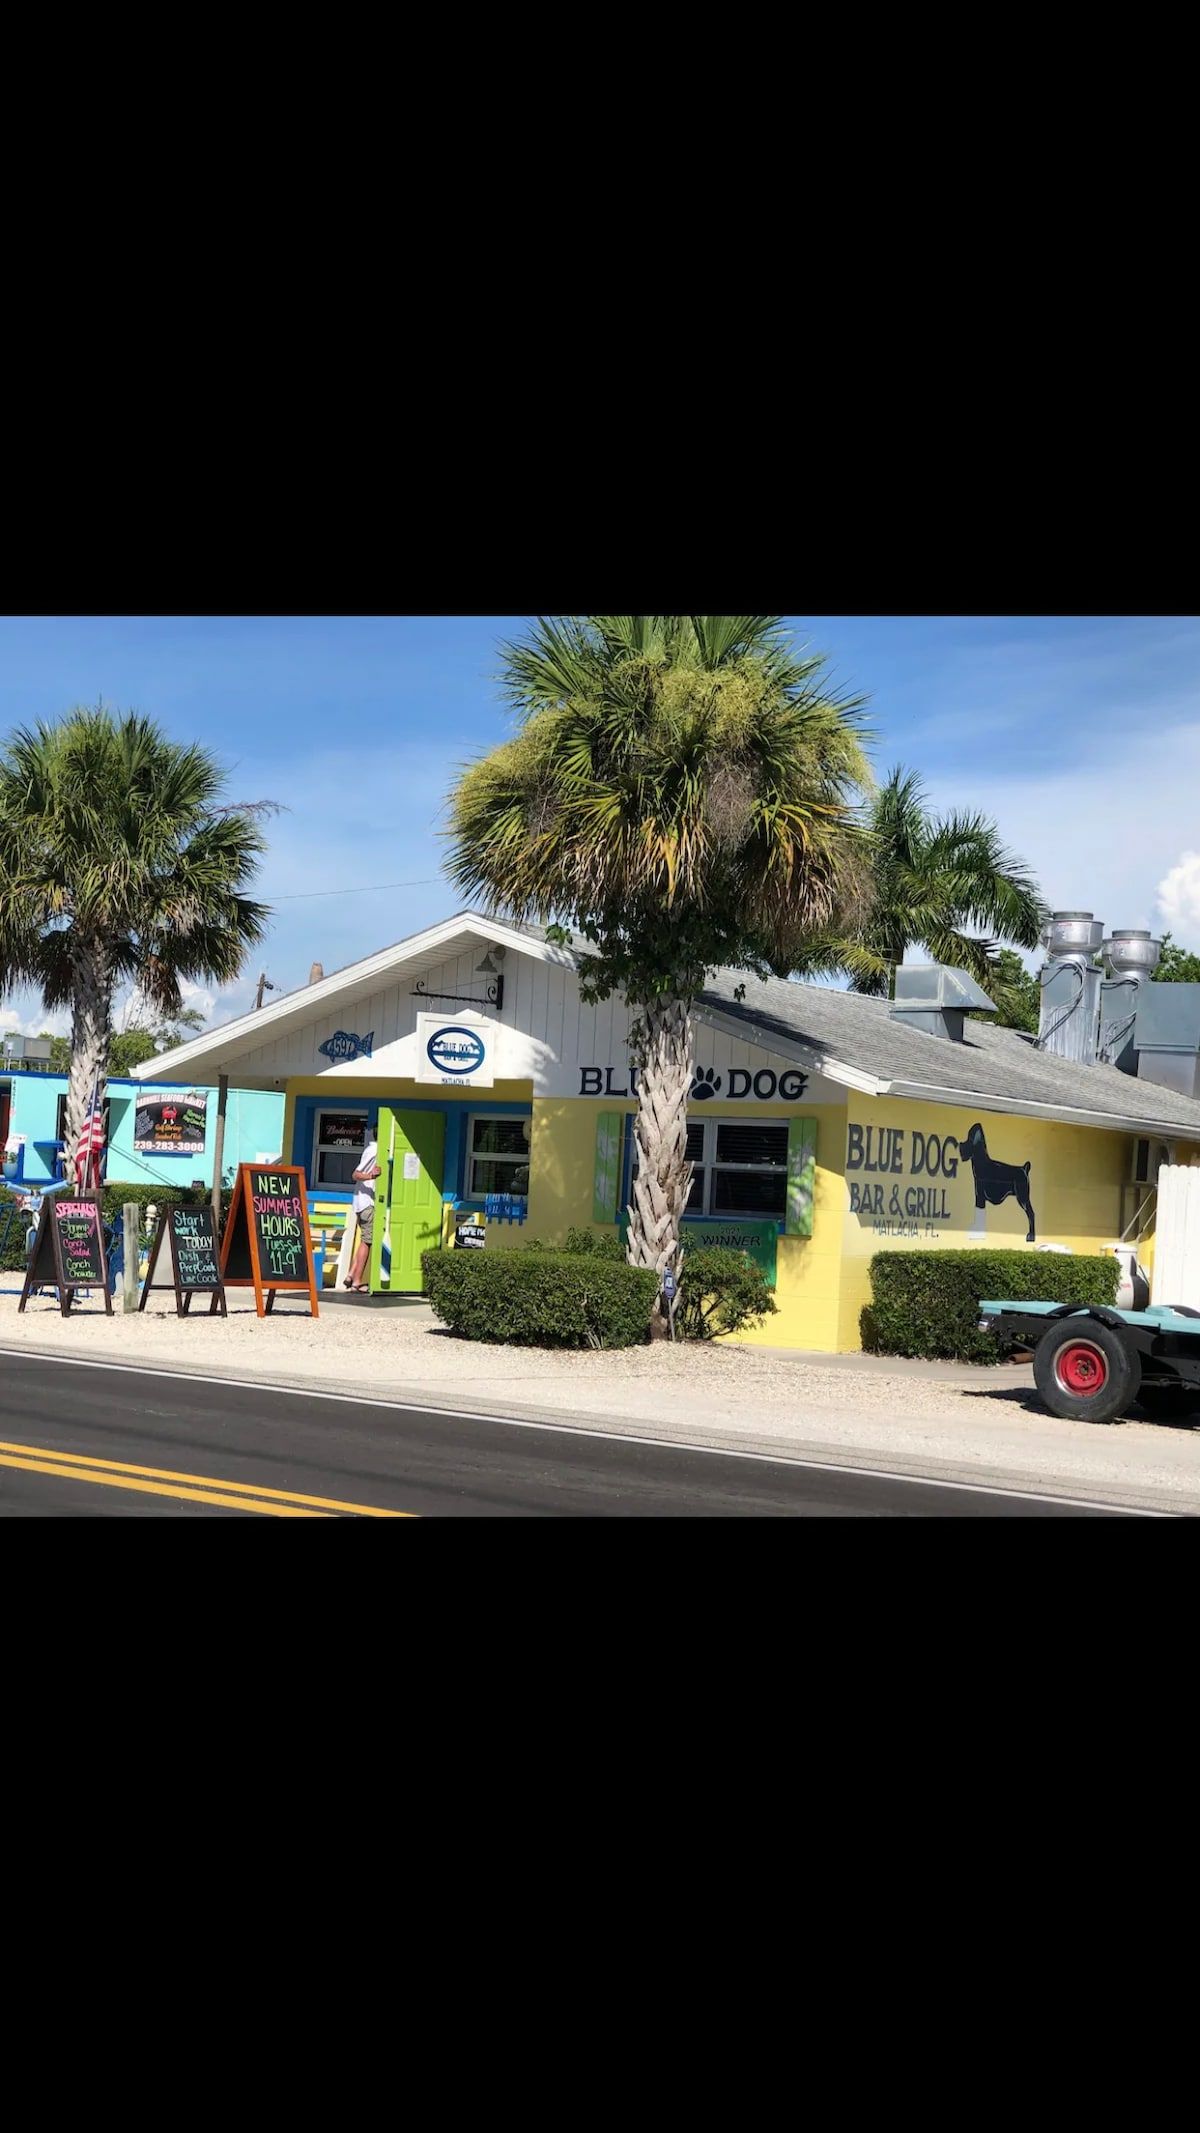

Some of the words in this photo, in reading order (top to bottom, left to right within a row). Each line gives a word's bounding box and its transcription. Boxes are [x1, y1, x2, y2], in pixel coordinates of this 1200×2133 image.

[459, 1043, 471, 1054] DOG
[726, 1069, 808, 1100] DOG
[846, 1123, 904, 1174] BLUE
[911, 1131, 959, 1178] DOG
[258, 1175, 291, 1195] NEW
[56, 1202, 97, 1218] SPECIALS
[253, 1196, 302, 1217] SUMMER
[850, 1182, 885, 1214] BAR
[889, 1183, 904, 1219] &
[905, 1186, 951, 1219] GRILL
[174, 1210, 204, 1227] Start
[261, 1214, 301, 1237] HOURS
[700, 1235, 761, 1247] WINNER
[66, 1257, 91, 1269] Conch
[270, 1251, 297, 1275] 11-9
